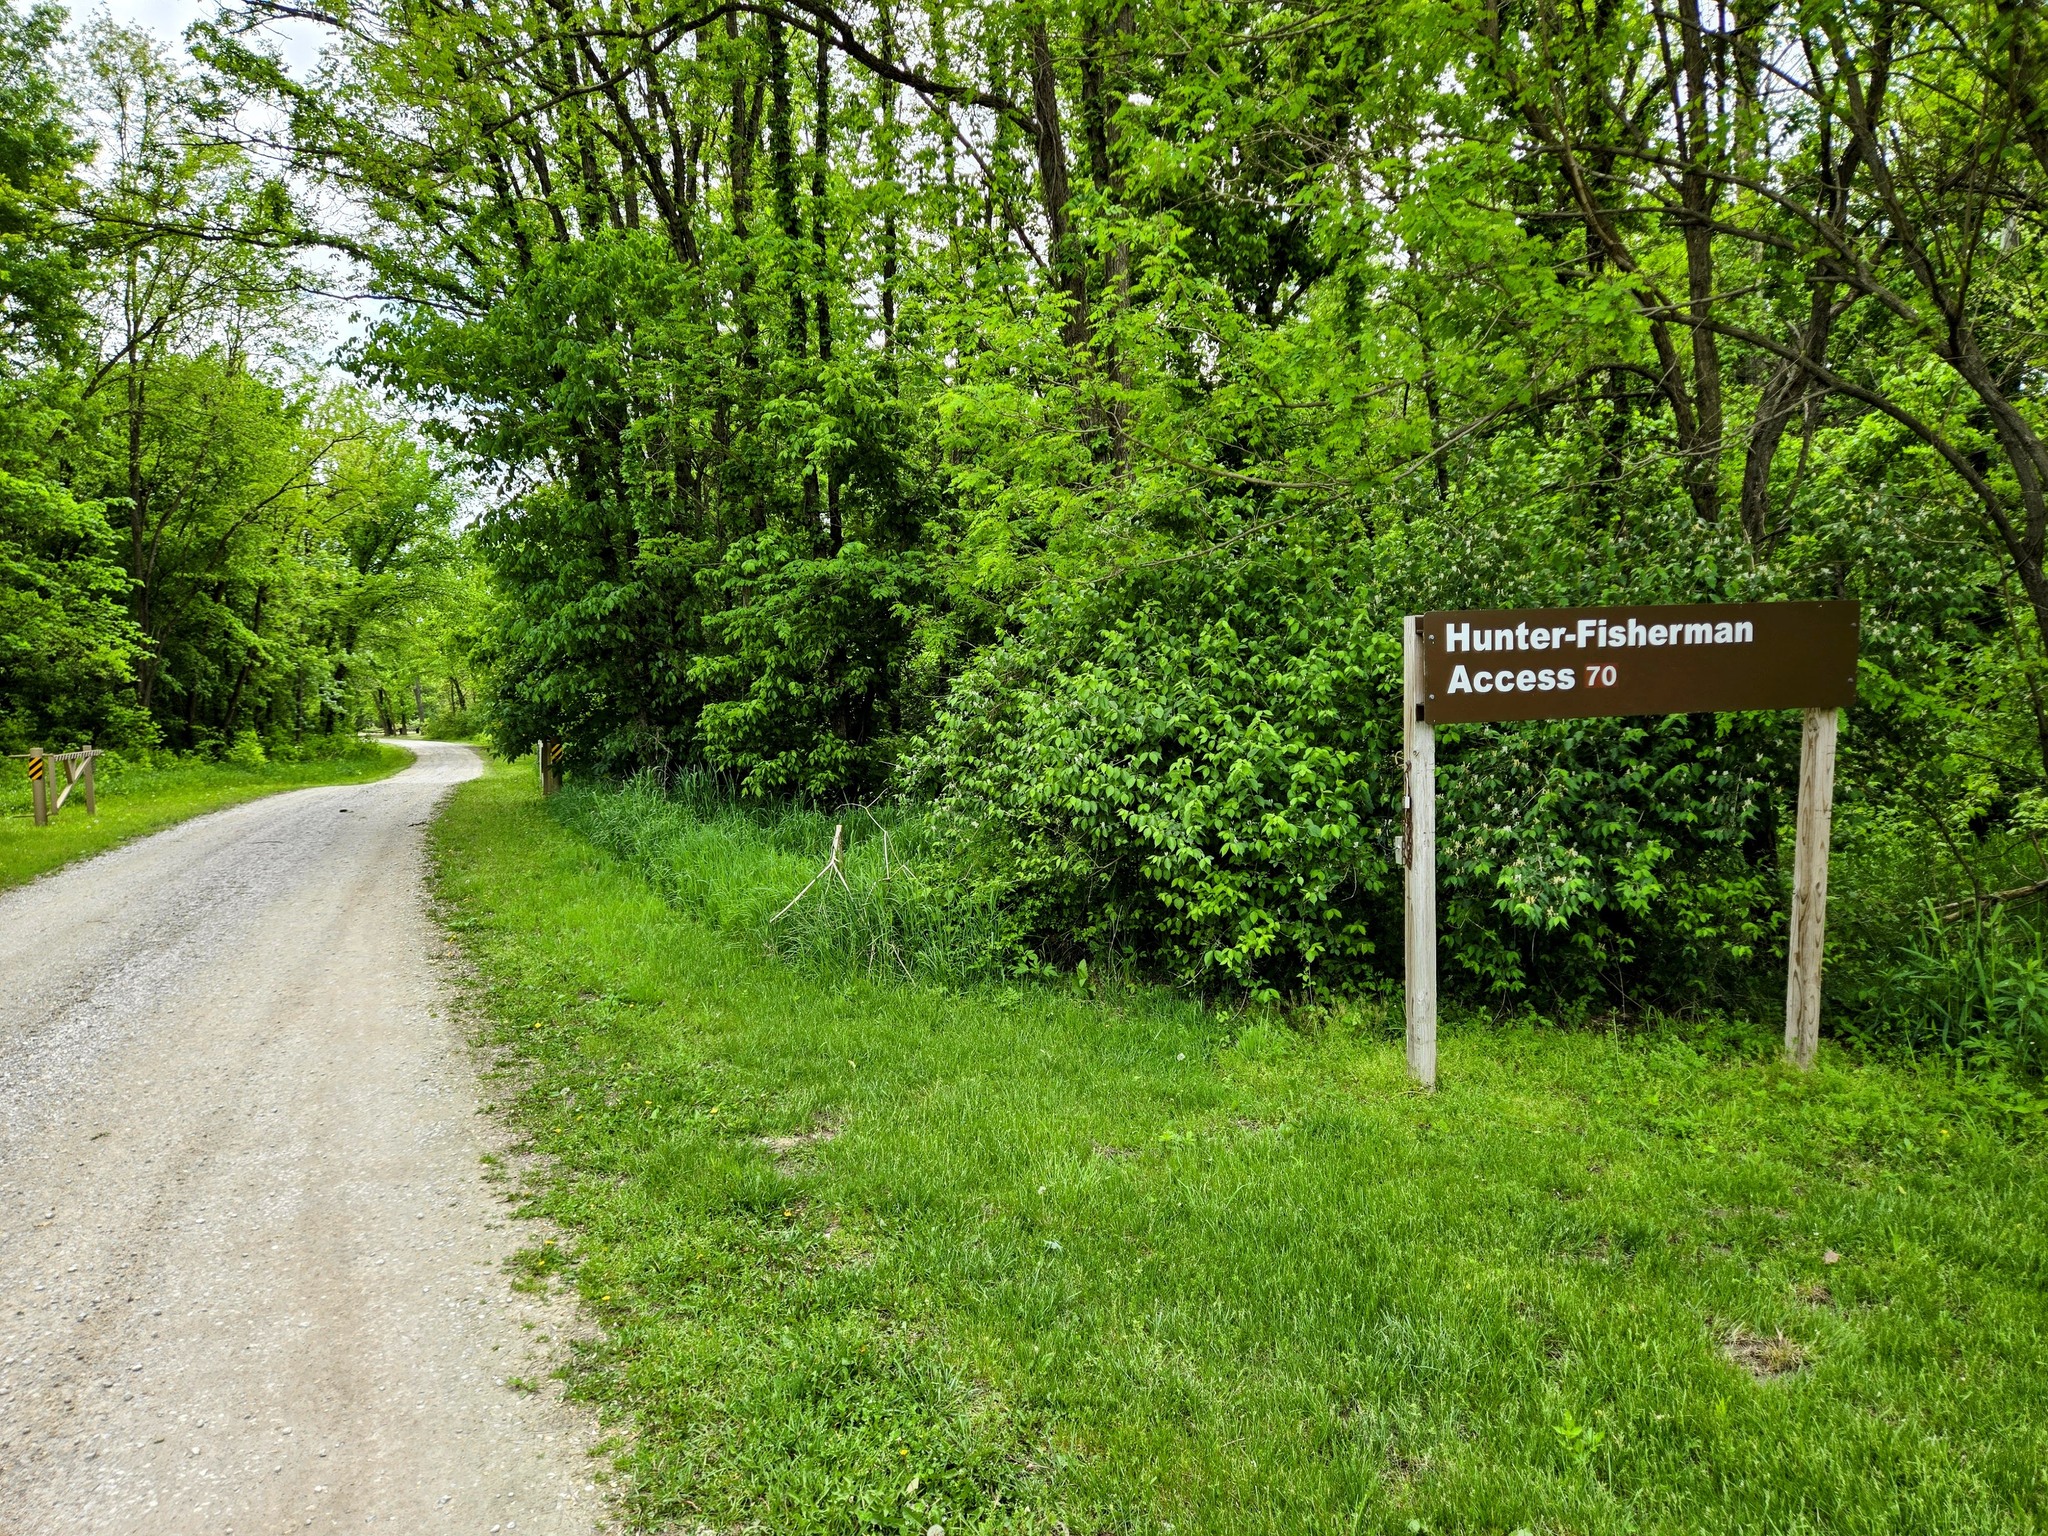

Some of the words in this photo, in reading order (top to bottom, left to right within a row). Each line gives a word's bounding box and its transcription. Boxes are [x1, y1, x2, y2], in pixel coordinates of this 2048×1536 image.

[1445, 618, 1754, 653] Hunter-Fisherman
[1446, 664, 1576, 694] Access
[1586, 665, 1618, 687] 70
